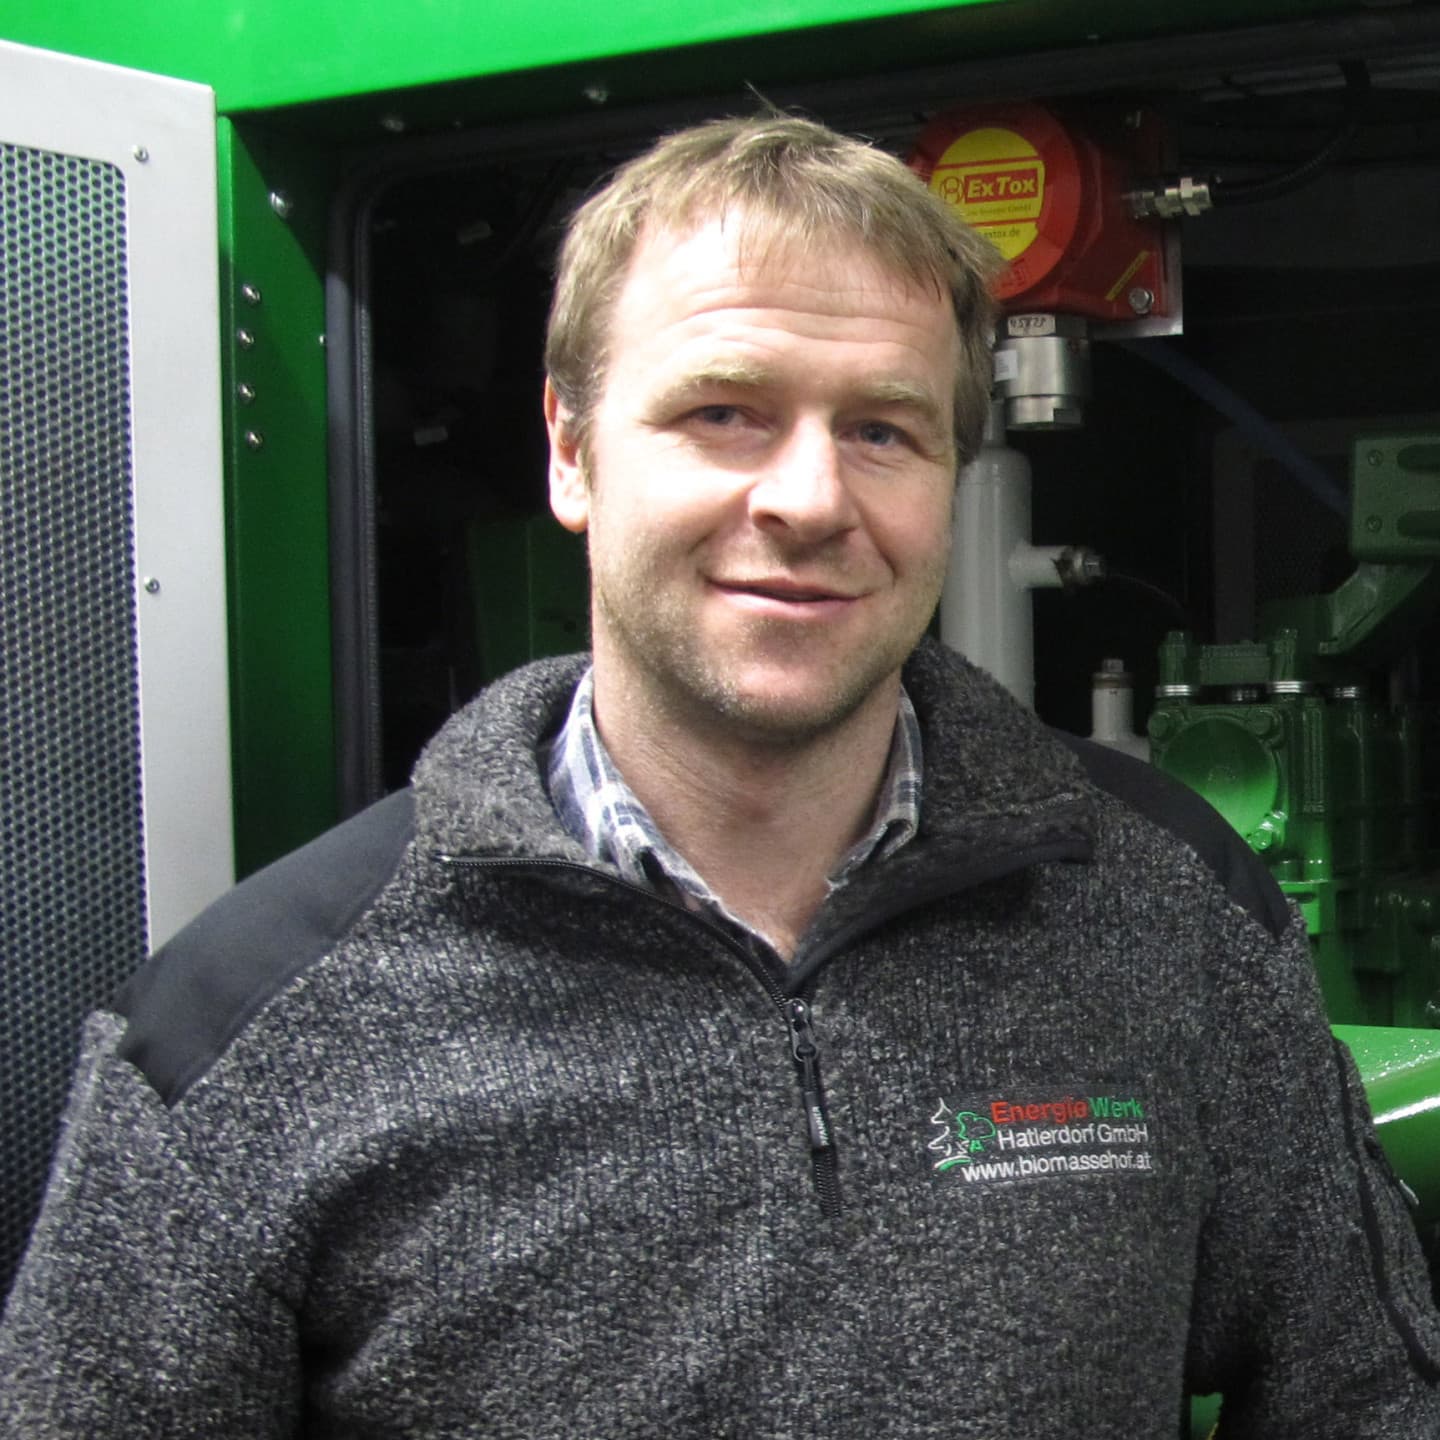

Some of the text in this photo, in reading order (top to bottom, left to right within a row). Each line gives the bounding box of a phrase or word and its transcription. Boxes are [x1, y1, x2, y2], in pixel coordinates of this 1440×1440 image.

[968, 175, 1035, 199] ExTox
[997, 1122, 1149, 1150] Hatlerdorf GmbH
[961, 1151, 1152, 1182] www.biomassehof.at
